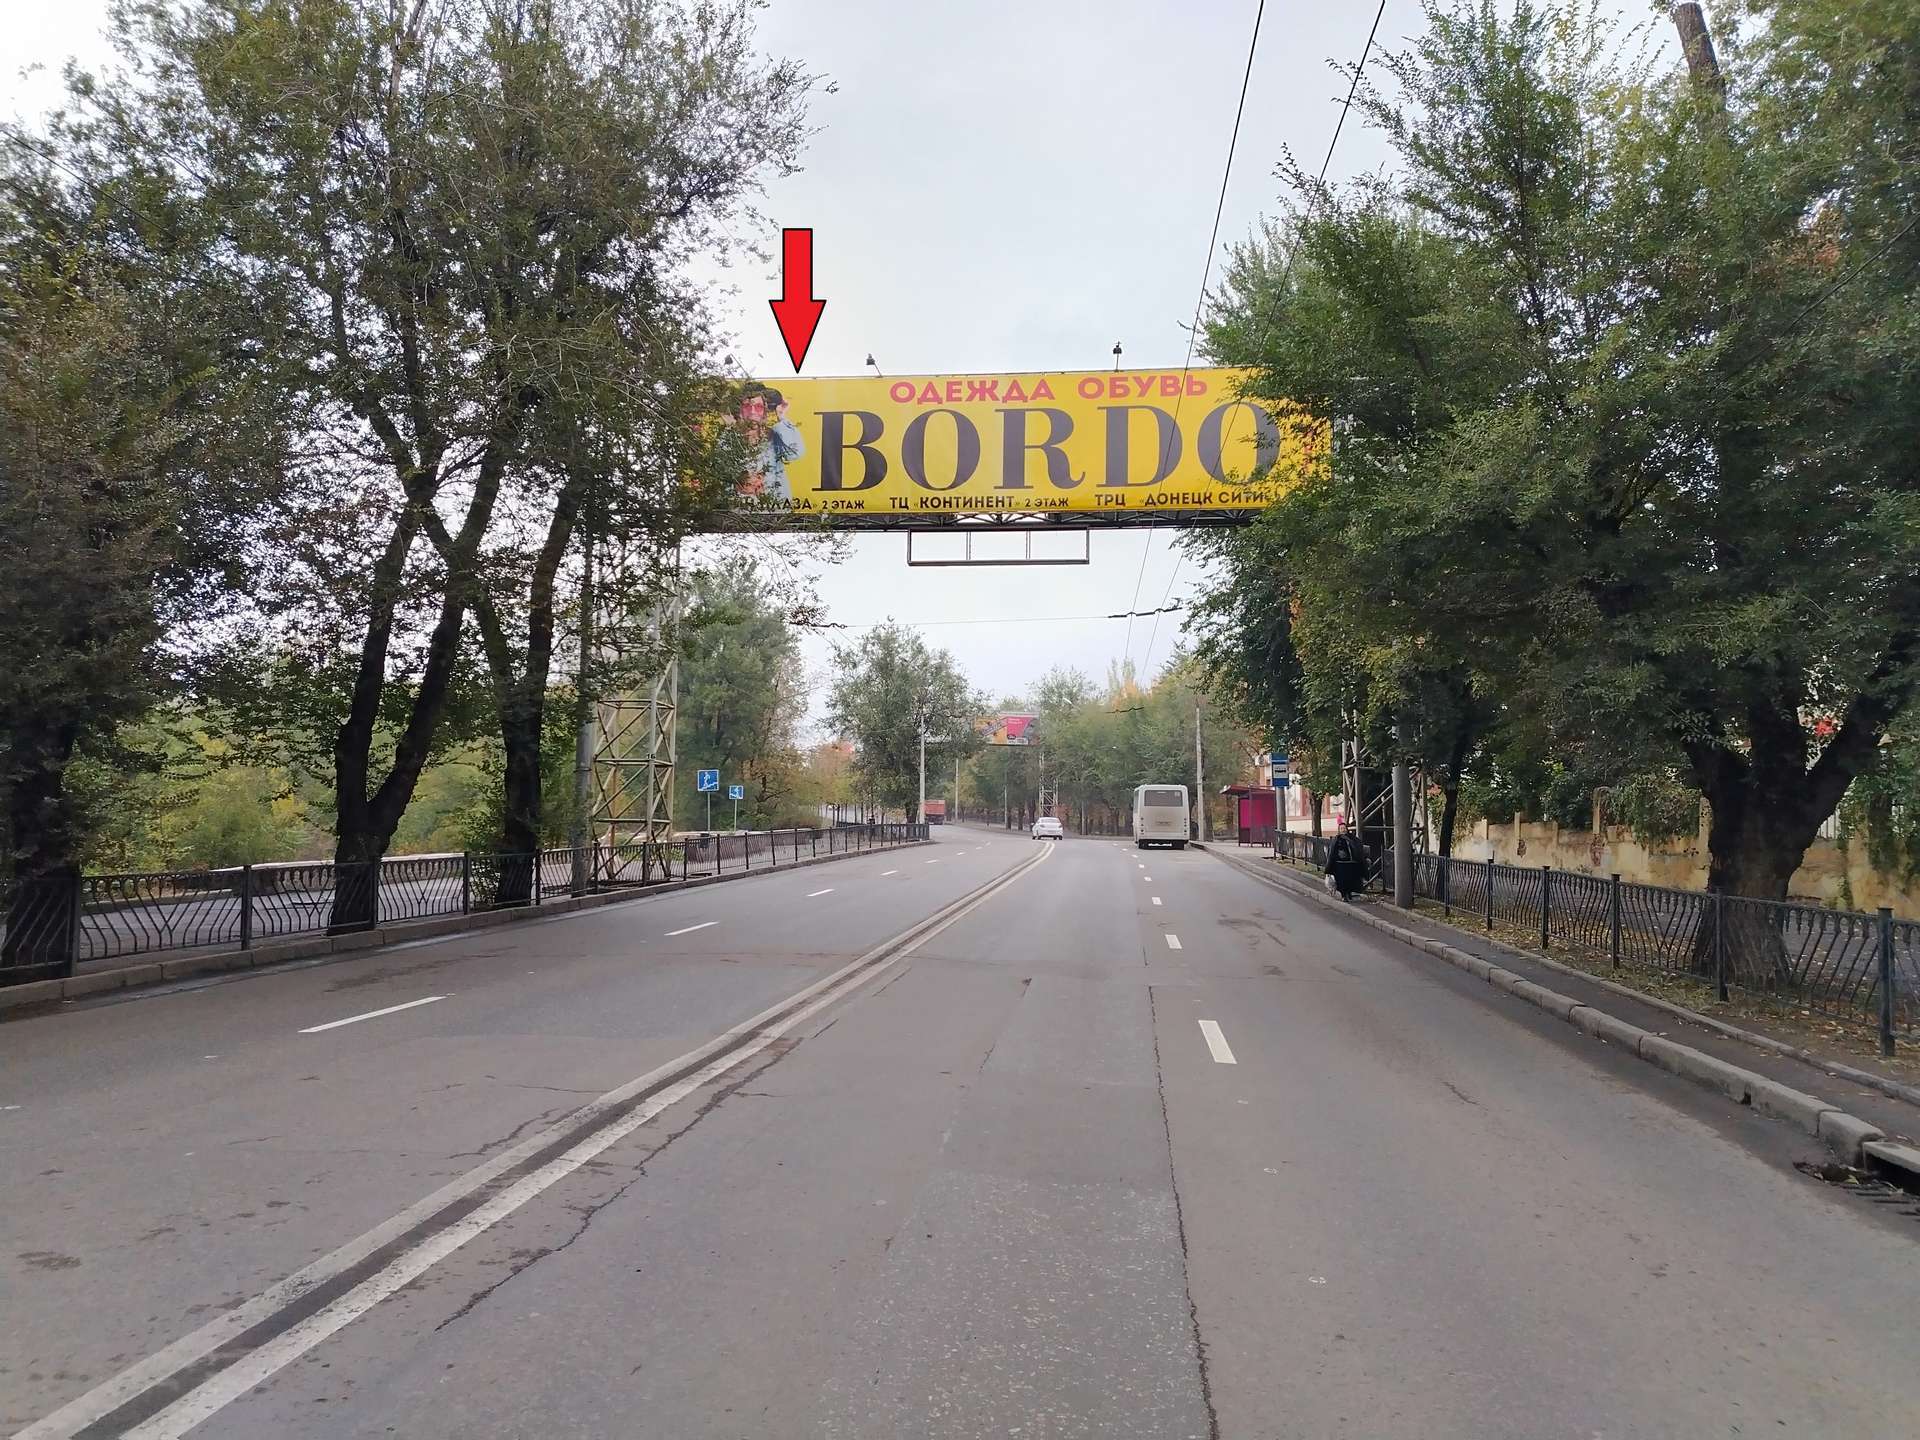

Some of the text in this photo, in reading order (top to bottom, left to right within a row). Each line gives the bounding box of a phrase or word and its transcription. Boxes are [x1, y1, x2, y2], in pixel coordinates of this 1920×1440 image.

[889, 375, 1207, 405] ОДЕЖДА ОБУВЬ
[811, 402, 1281, 492] BORDO
[822, 500, 828, 510] 2
[832, 500, 865, 510] ЭТАЖ
[889, 496, 909, 510] ТЦ
[1025, 498, 1031, 508] 2
[1034, 497, 1069, 507] ЭТАЖ
[1095, 494, 1126, 507] ТРЦ
